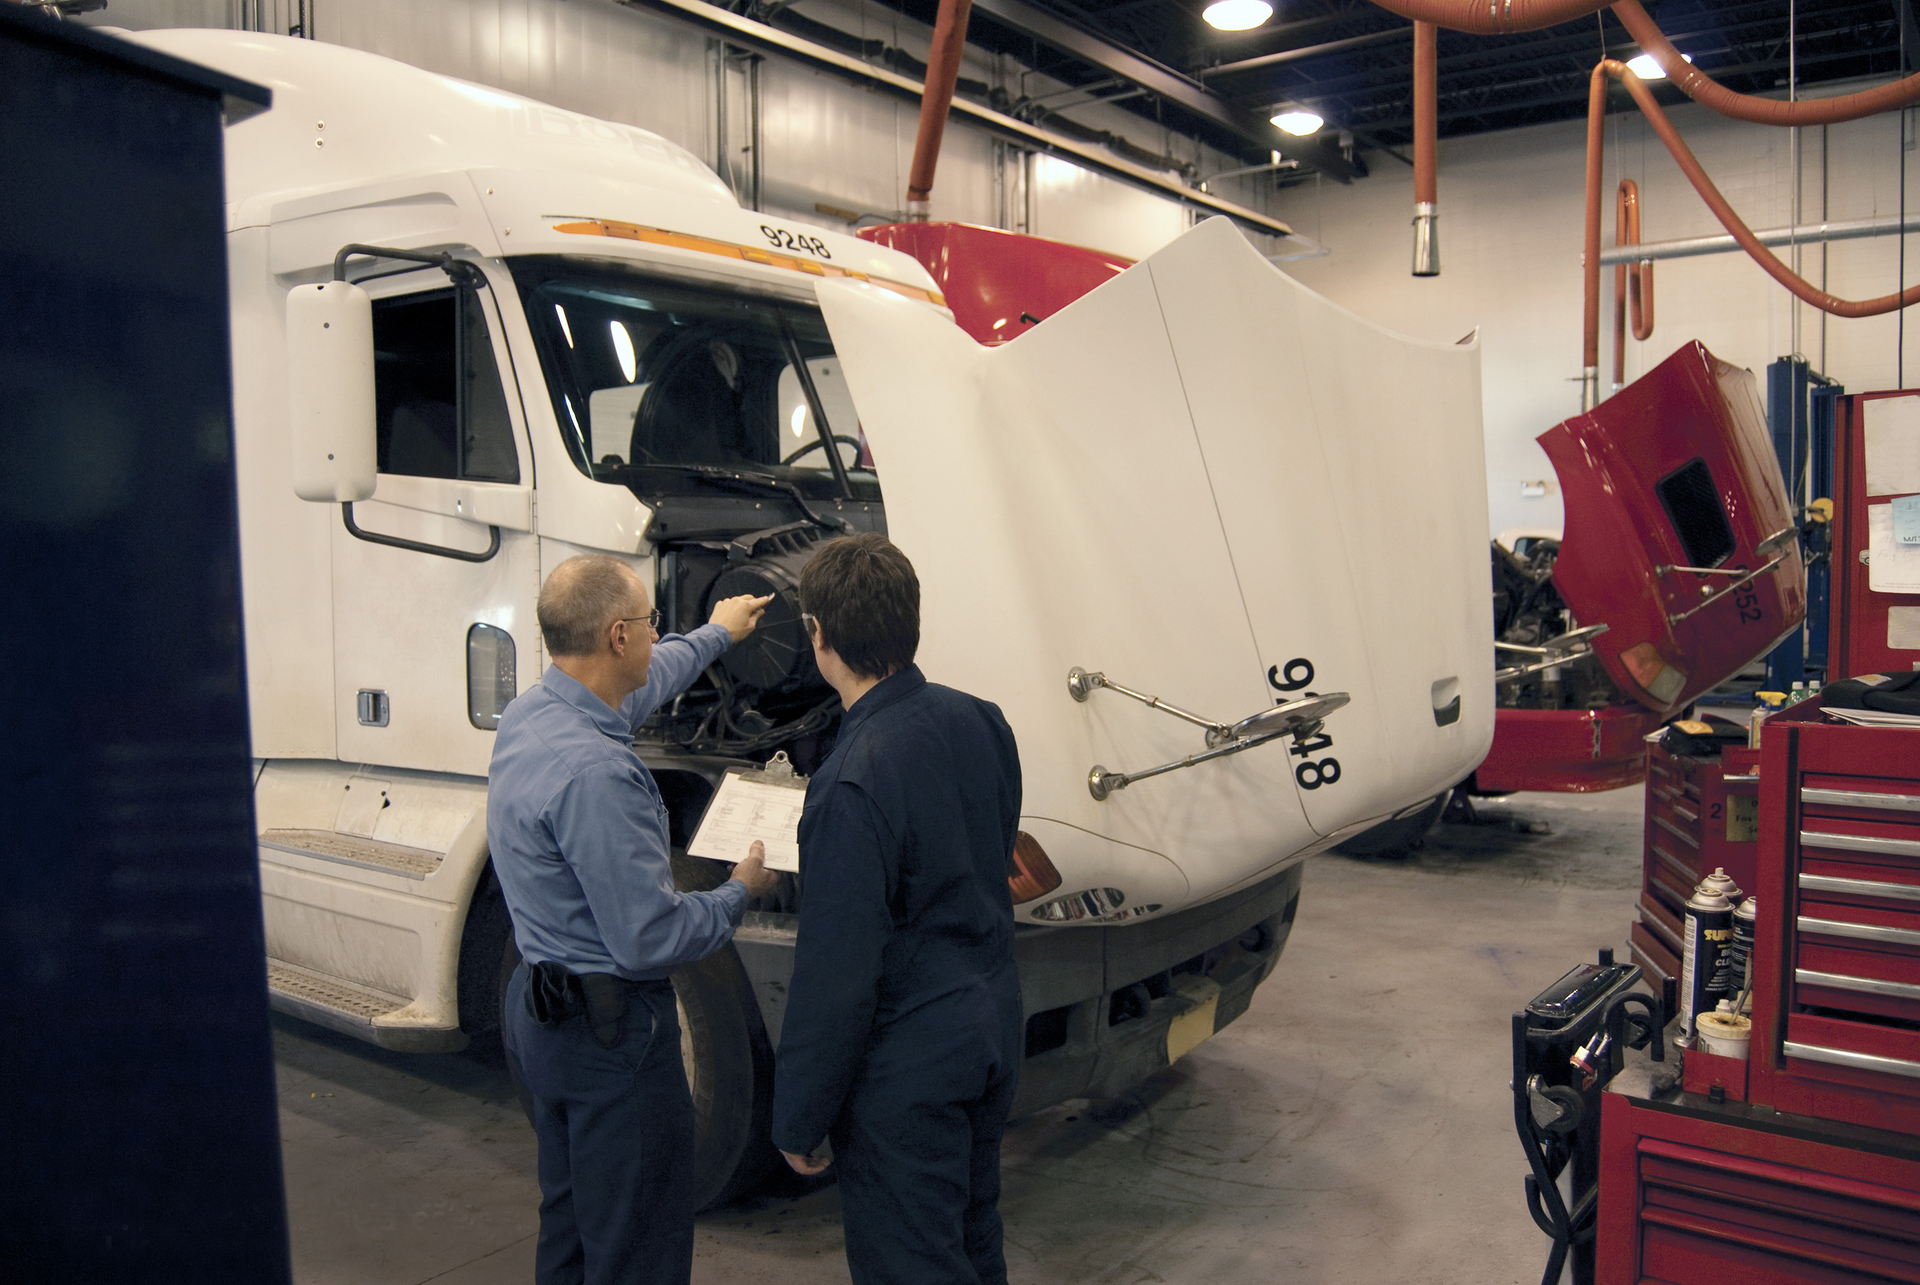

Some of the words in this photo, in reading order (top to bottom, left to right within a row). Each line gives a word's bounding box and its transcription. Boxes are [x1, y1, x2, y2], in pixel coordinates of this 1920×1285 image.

[760, 225, 831, 259] 9248
[1267, 657, 1342, 790] 948
[1709, 802, 1722, 819] 2
